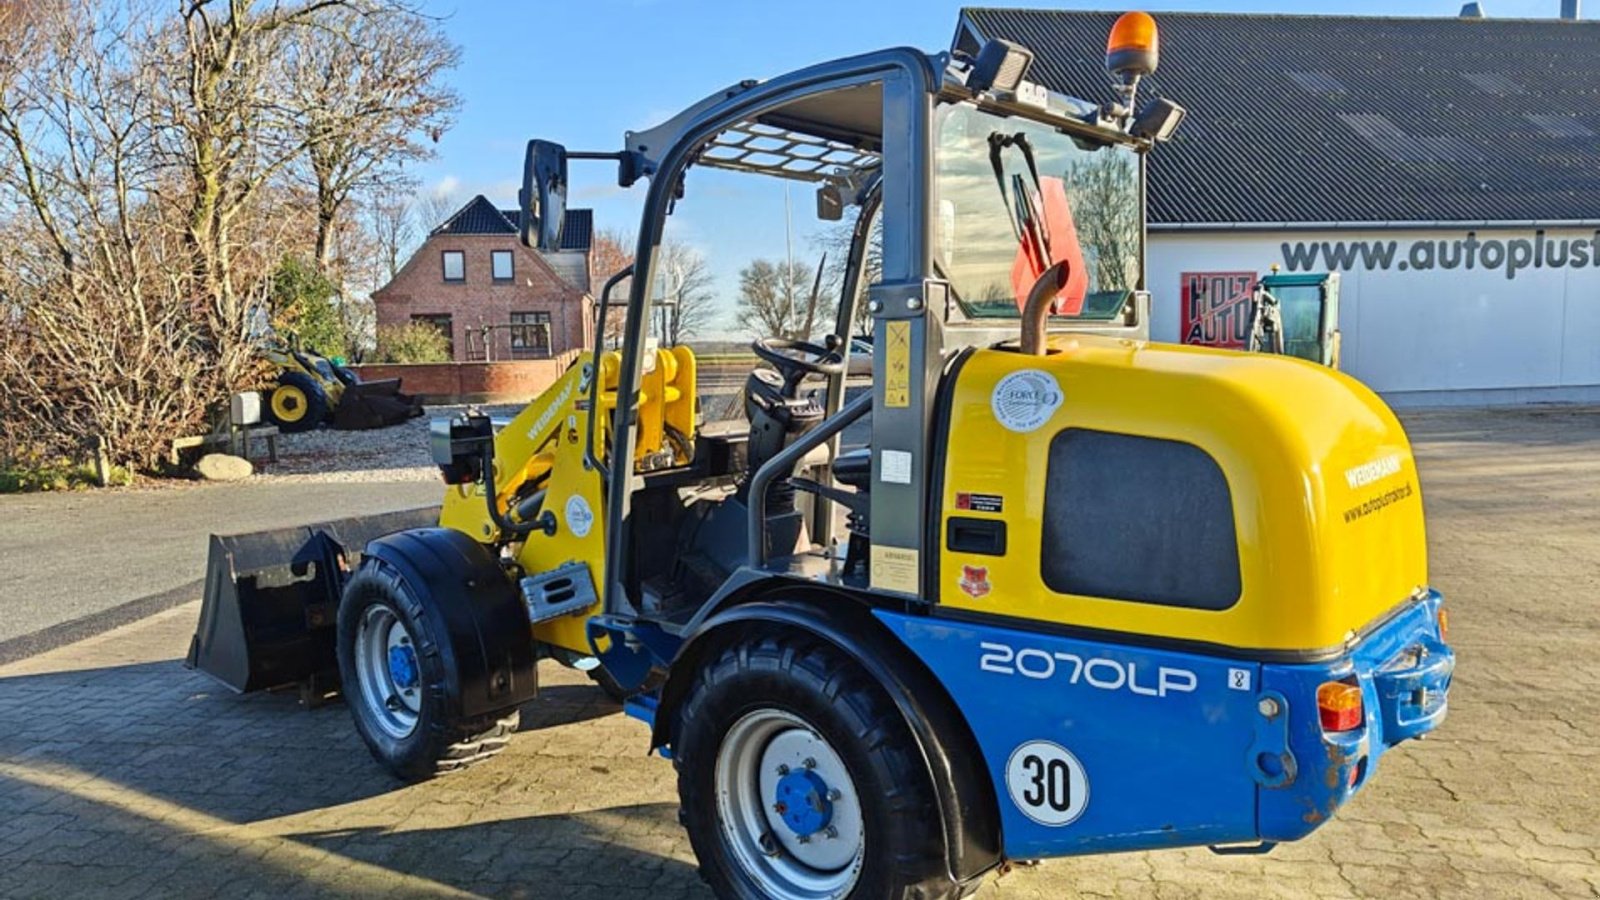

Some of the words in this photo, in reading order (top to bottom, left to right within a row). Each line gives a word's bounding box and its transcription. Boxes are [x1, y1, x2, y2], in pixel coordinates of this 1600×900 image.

[1186, 295, 1252, 343] AUTO
[1188, 275, 1252, 323] HOLT
[980, 642, 1197, 697] 2070LP
[1023, 755, 1070, 812] 30
